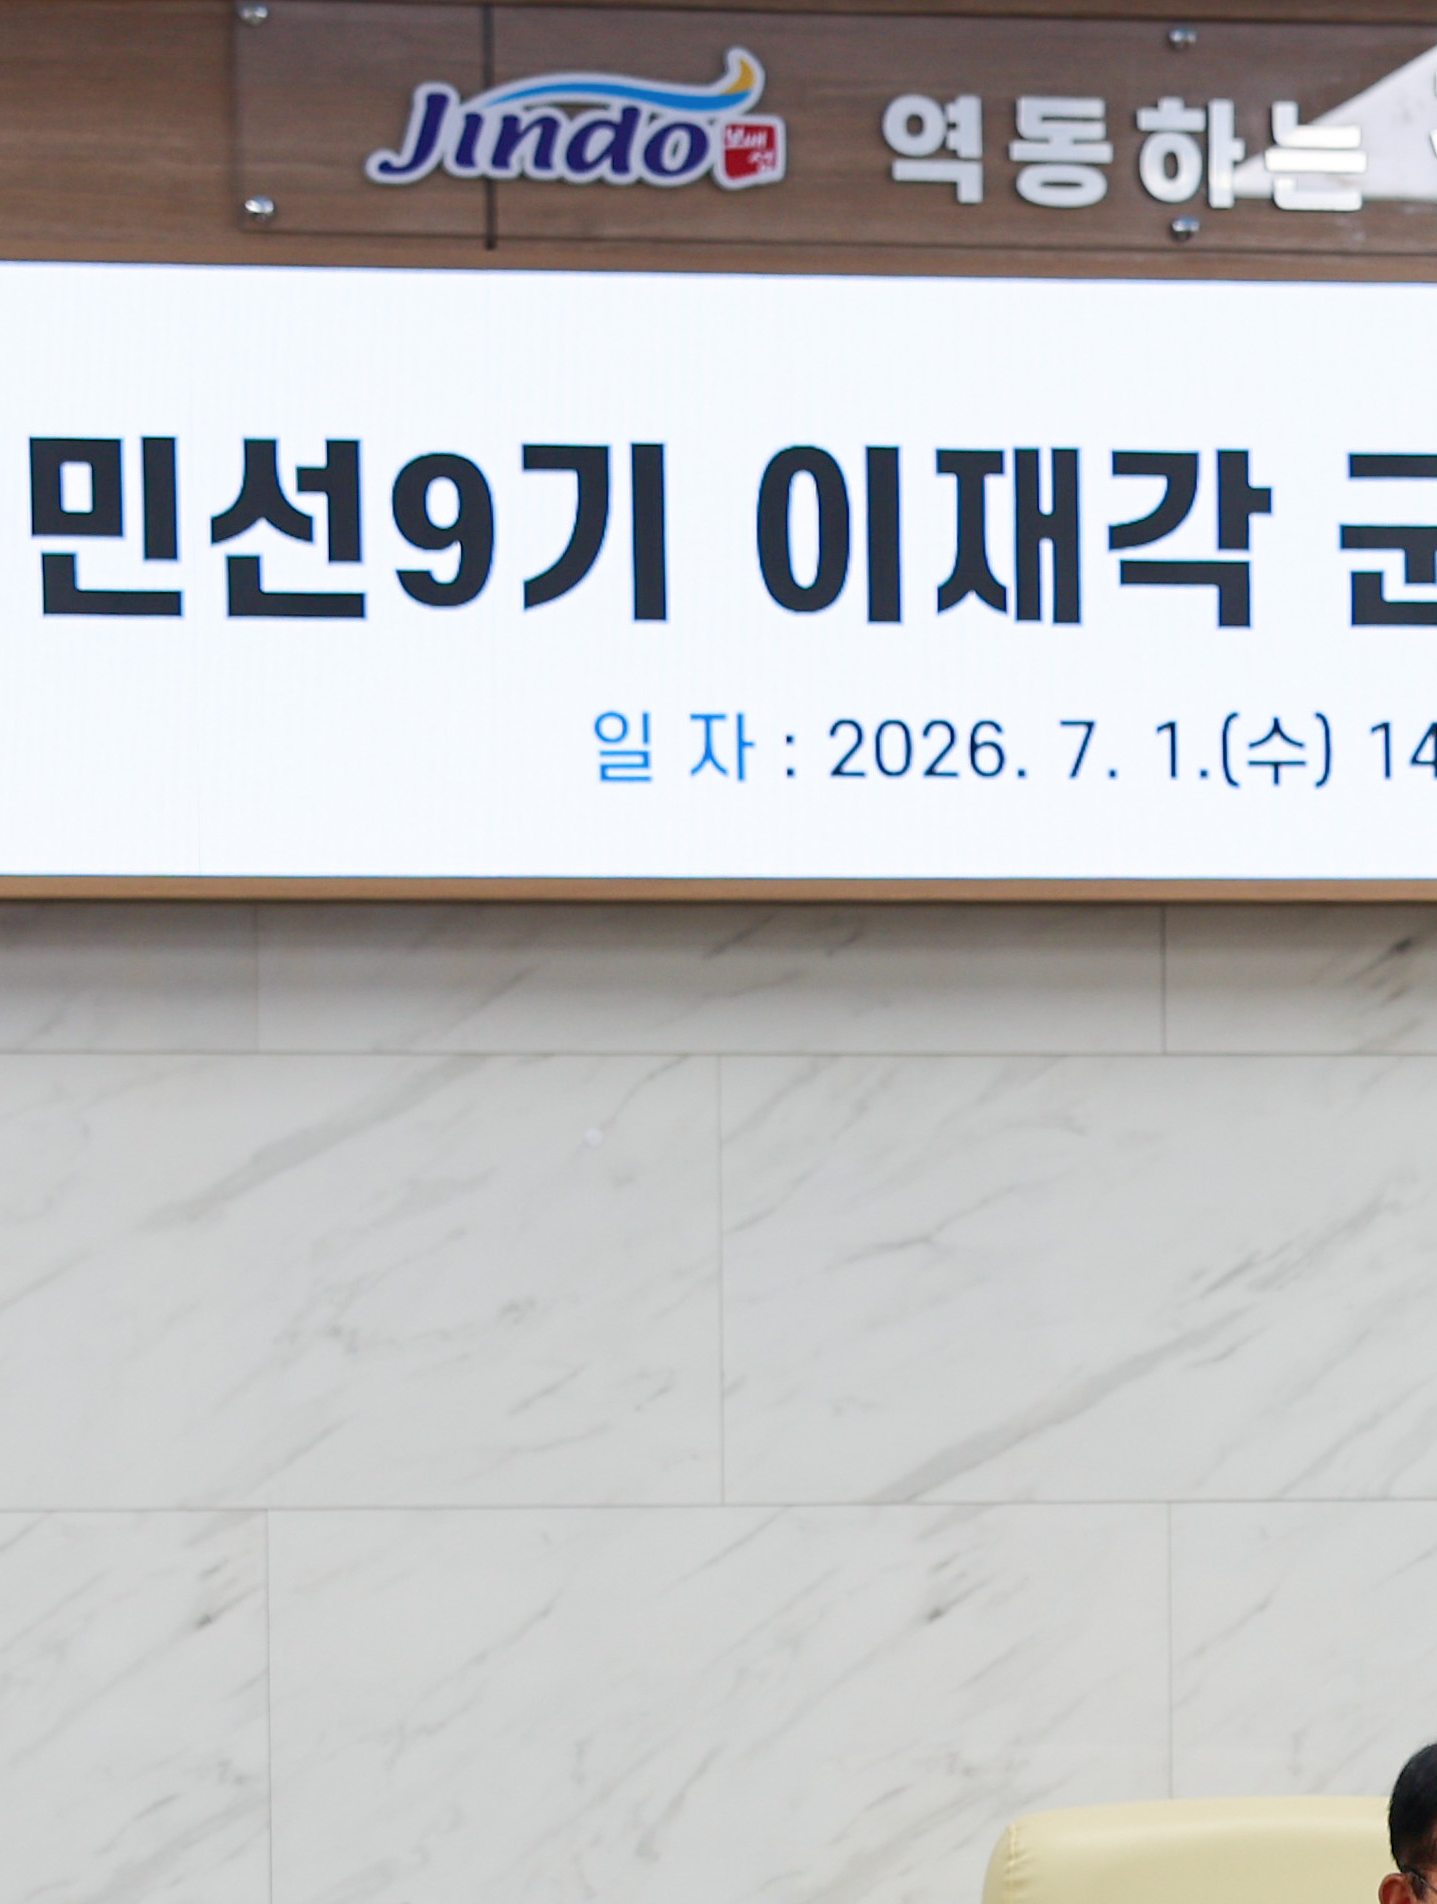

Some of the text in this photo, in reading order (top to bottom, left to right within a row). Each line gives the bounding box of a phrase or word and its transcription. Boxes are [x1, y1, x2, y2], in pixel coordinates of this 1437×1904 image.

[374, 91, 711, 178] Jindo
[882, 93, 1364, 213] 역동하는
[28, 436, 669, 623] 민선9기
[756, 444, 1273, 629] 이재각
[828, 717, 1028, 779] 2026.
[1059, 719, 1118, 780] 7.
[1155, 711, 1333, 790] 1.(수)
